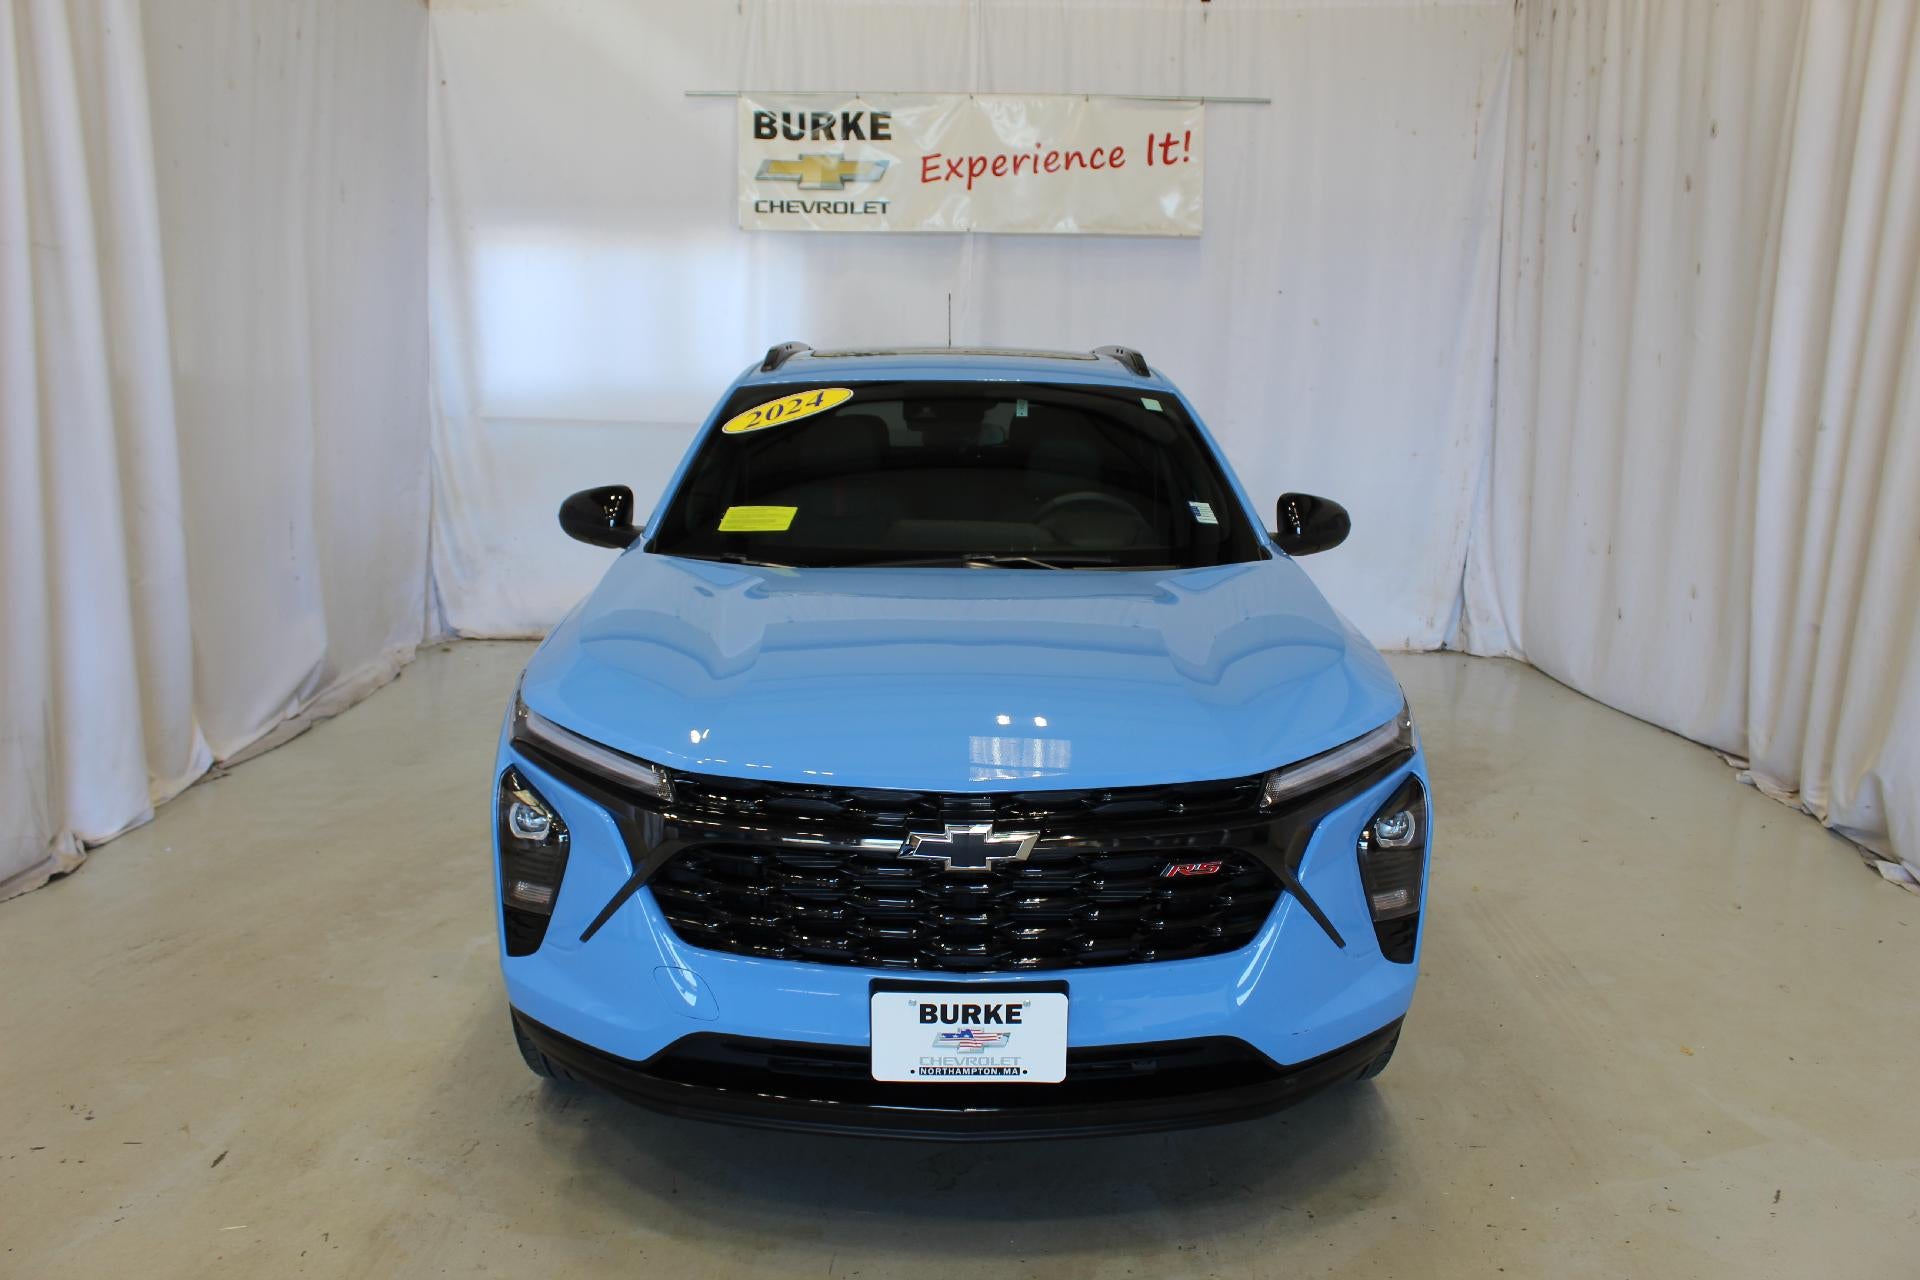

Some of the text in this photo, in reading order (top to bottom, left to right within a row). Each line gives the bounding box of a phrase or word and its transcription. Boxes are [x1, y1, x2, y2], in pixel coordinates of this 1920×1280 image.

[753, 111, 892, 141] BURKE
[920, 130, 1191, 190] Experience It!
[754, 199, 891, 215] CHEVROLET
[744, 391, 825, 428] 2024
[919, 1003, 1023, 1025] BURKE
[919, 1056, 1021, 1066] CHEVROLET
[1003, 1067, 1018, 1075] MA
